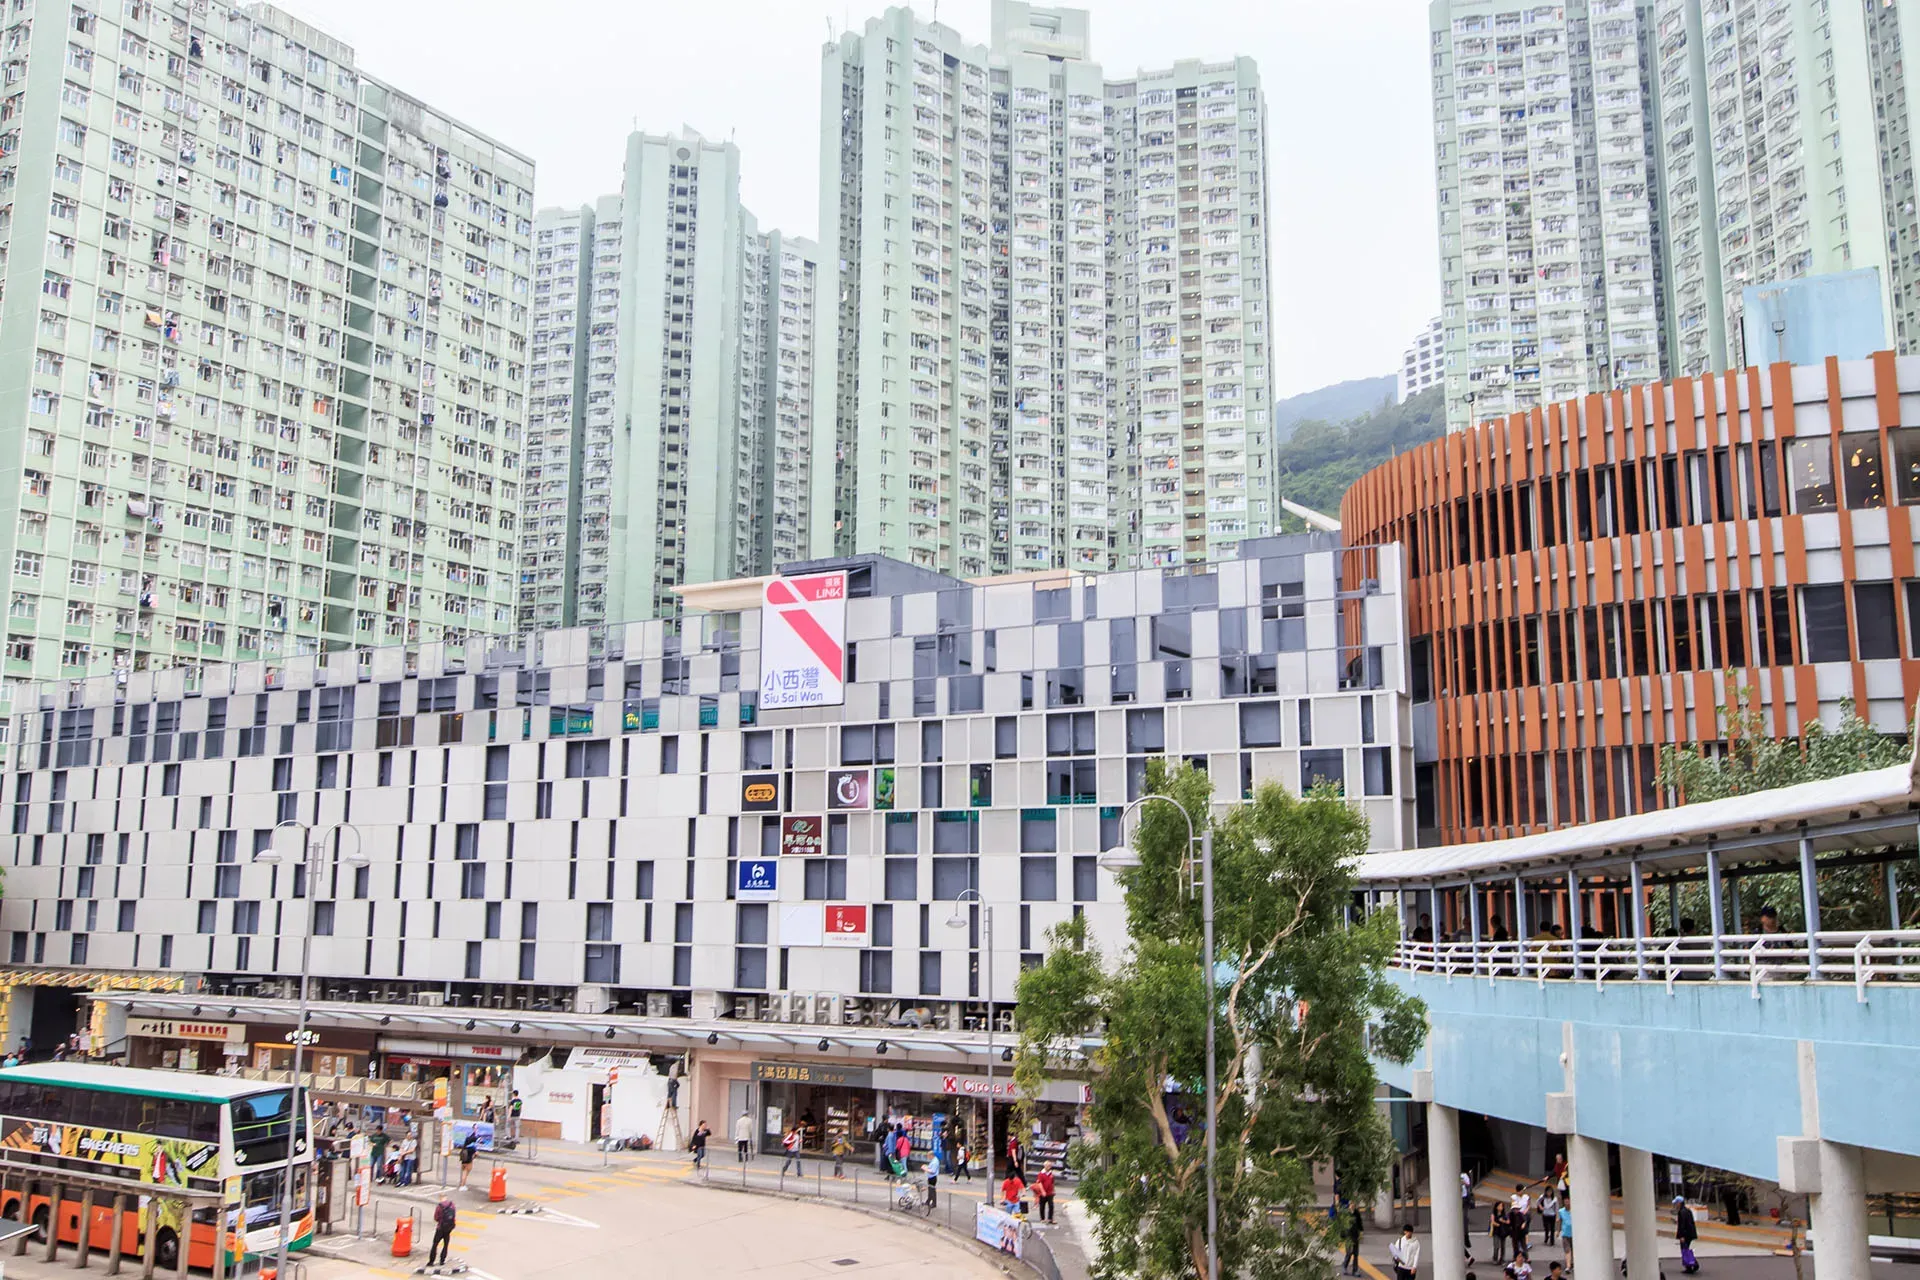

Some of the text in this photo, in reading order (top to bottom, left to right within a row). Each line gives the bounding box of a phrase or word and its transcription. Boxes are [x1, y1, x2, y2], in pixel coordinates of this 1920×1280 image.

[816, 587, 841, 599] LINK
[764, 666, 820, 691] 小西灣
[764, 690, 823, 704] Siu Sai Wan
[963, 1079, 1002, 1094] Circe
[80, 1137, 140, 1157] SKECHERS
